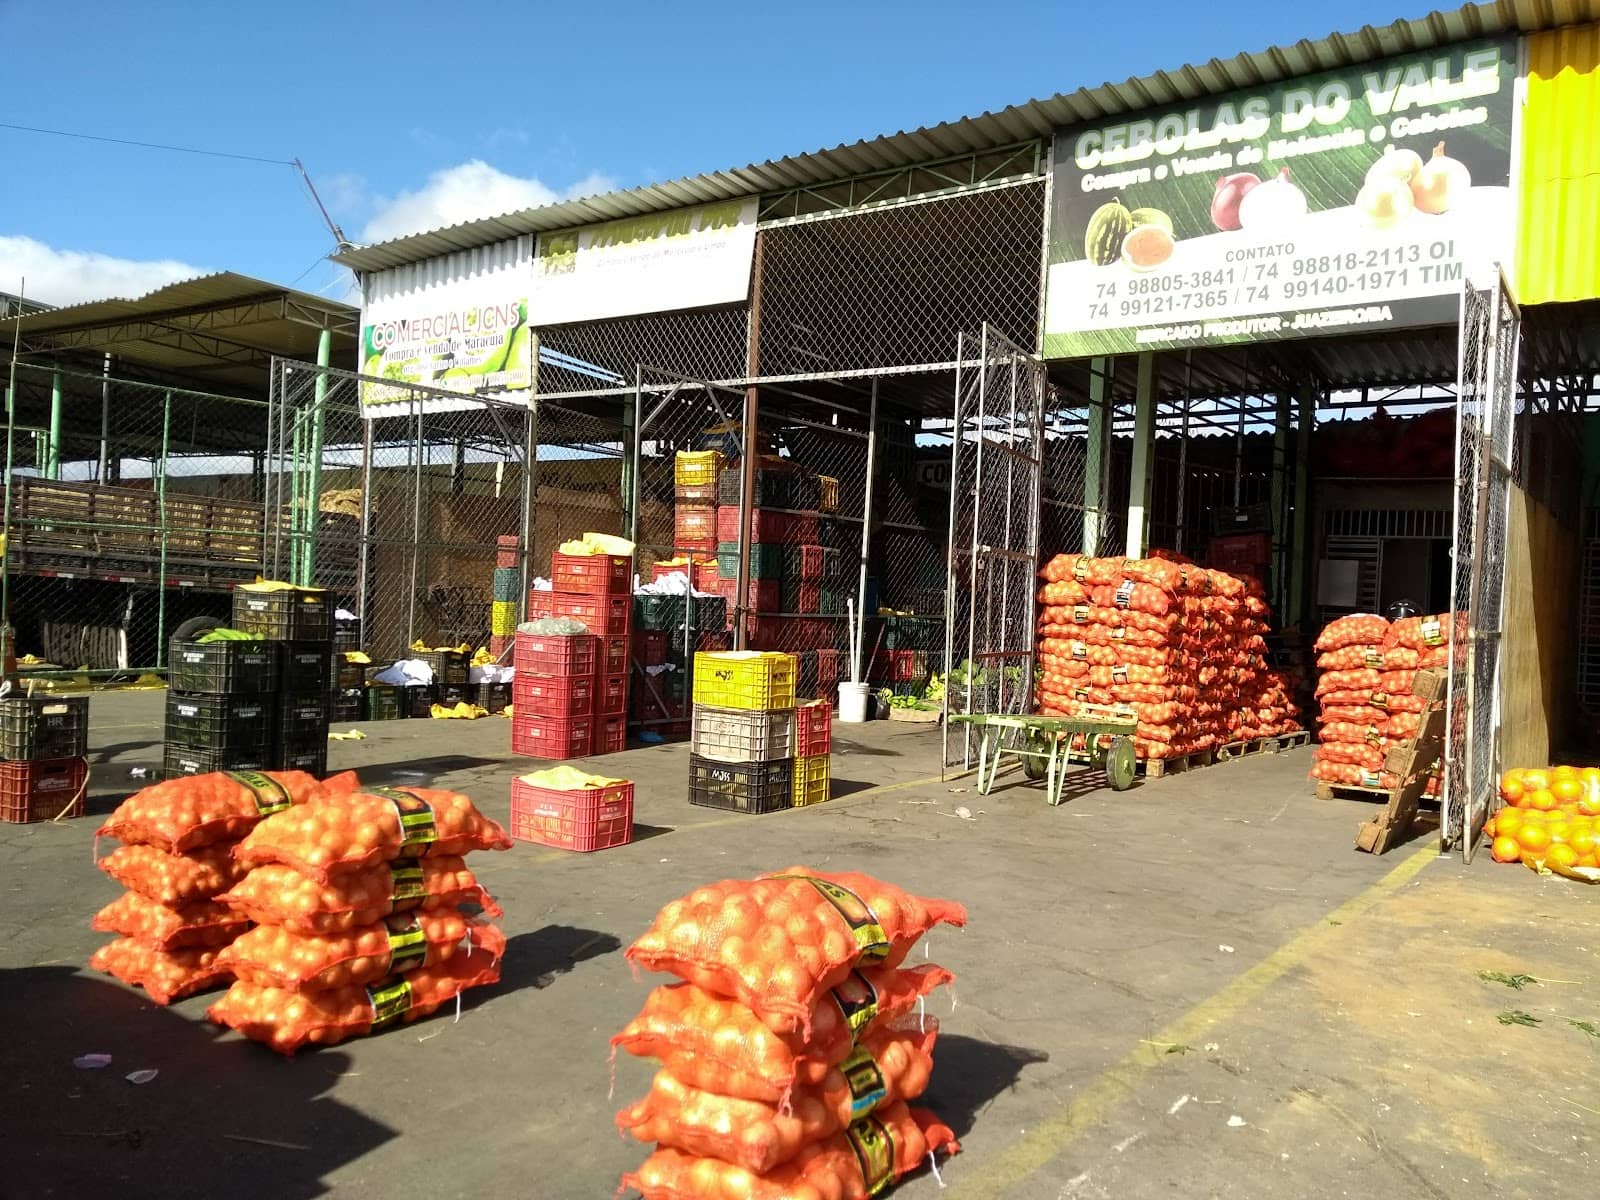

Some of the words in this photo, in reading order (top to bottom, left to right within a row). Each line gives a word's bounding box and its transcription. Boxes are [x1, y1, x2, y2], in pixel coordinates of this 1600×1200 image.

[1074, 97, 1270, 170] CEBOLAS
[1281, 81, 1351, 132] DO
[1362, 47, 1500, 115] VALE
[1081, 163, 1151, 192] Compra
[1154, 164, 1168, 181] e
[1171, 152, 1234, 177] Venda
[1236, 144, 1264, 166] de
[1369, 125, 1387, 143] e
[1390, 103, 1488, 139] Cebolas
[1096, 281, 1117, 299] 74
[1128, 268, 1235, 296] 98805-3841
[1254, 262, 1279, 281] 74
[1292, 245, 1421, 276] 98818-2113
[1428, 239, 1455, 260] OI
[1225, 242, 1296, 263] CONTATO
[1088, 303, 1109, 320] 74
[1120, 290, 1227, 317] 99121-7365
[1246, 284, 1270, 303] 74
[1283, 269, 1410, 300] 99140-1971
[1419, 261, 1463, 285] TIM
[373, 311, 472, 348] COMERCIAL
[1135, 323, 1202, 344] MERCADO
[1203, 317, 1281, 338] PRODUTOR
